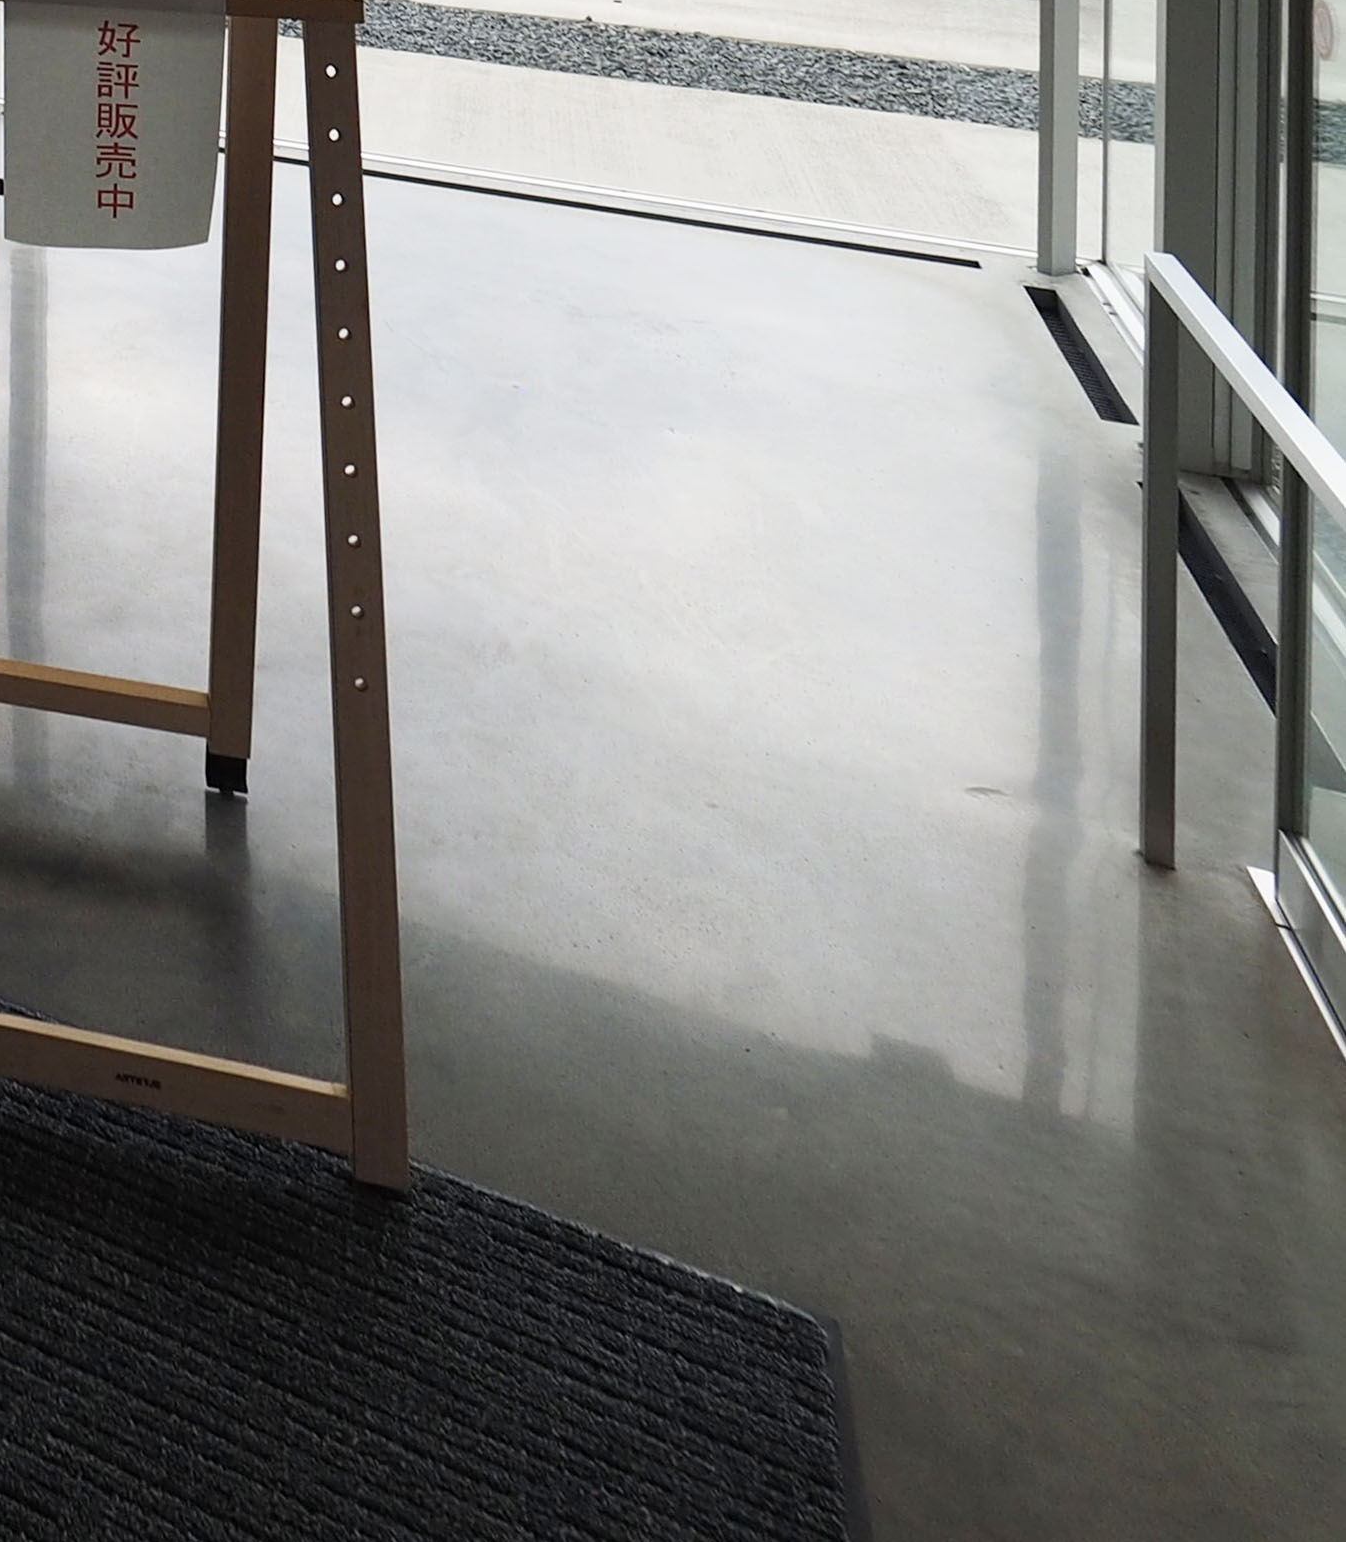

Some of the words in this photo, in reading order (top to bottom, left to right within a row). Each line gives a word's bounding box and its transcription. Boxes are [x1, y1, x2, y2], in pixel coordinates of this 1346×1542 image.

[94, 19, 142, 219] 好評販売中
